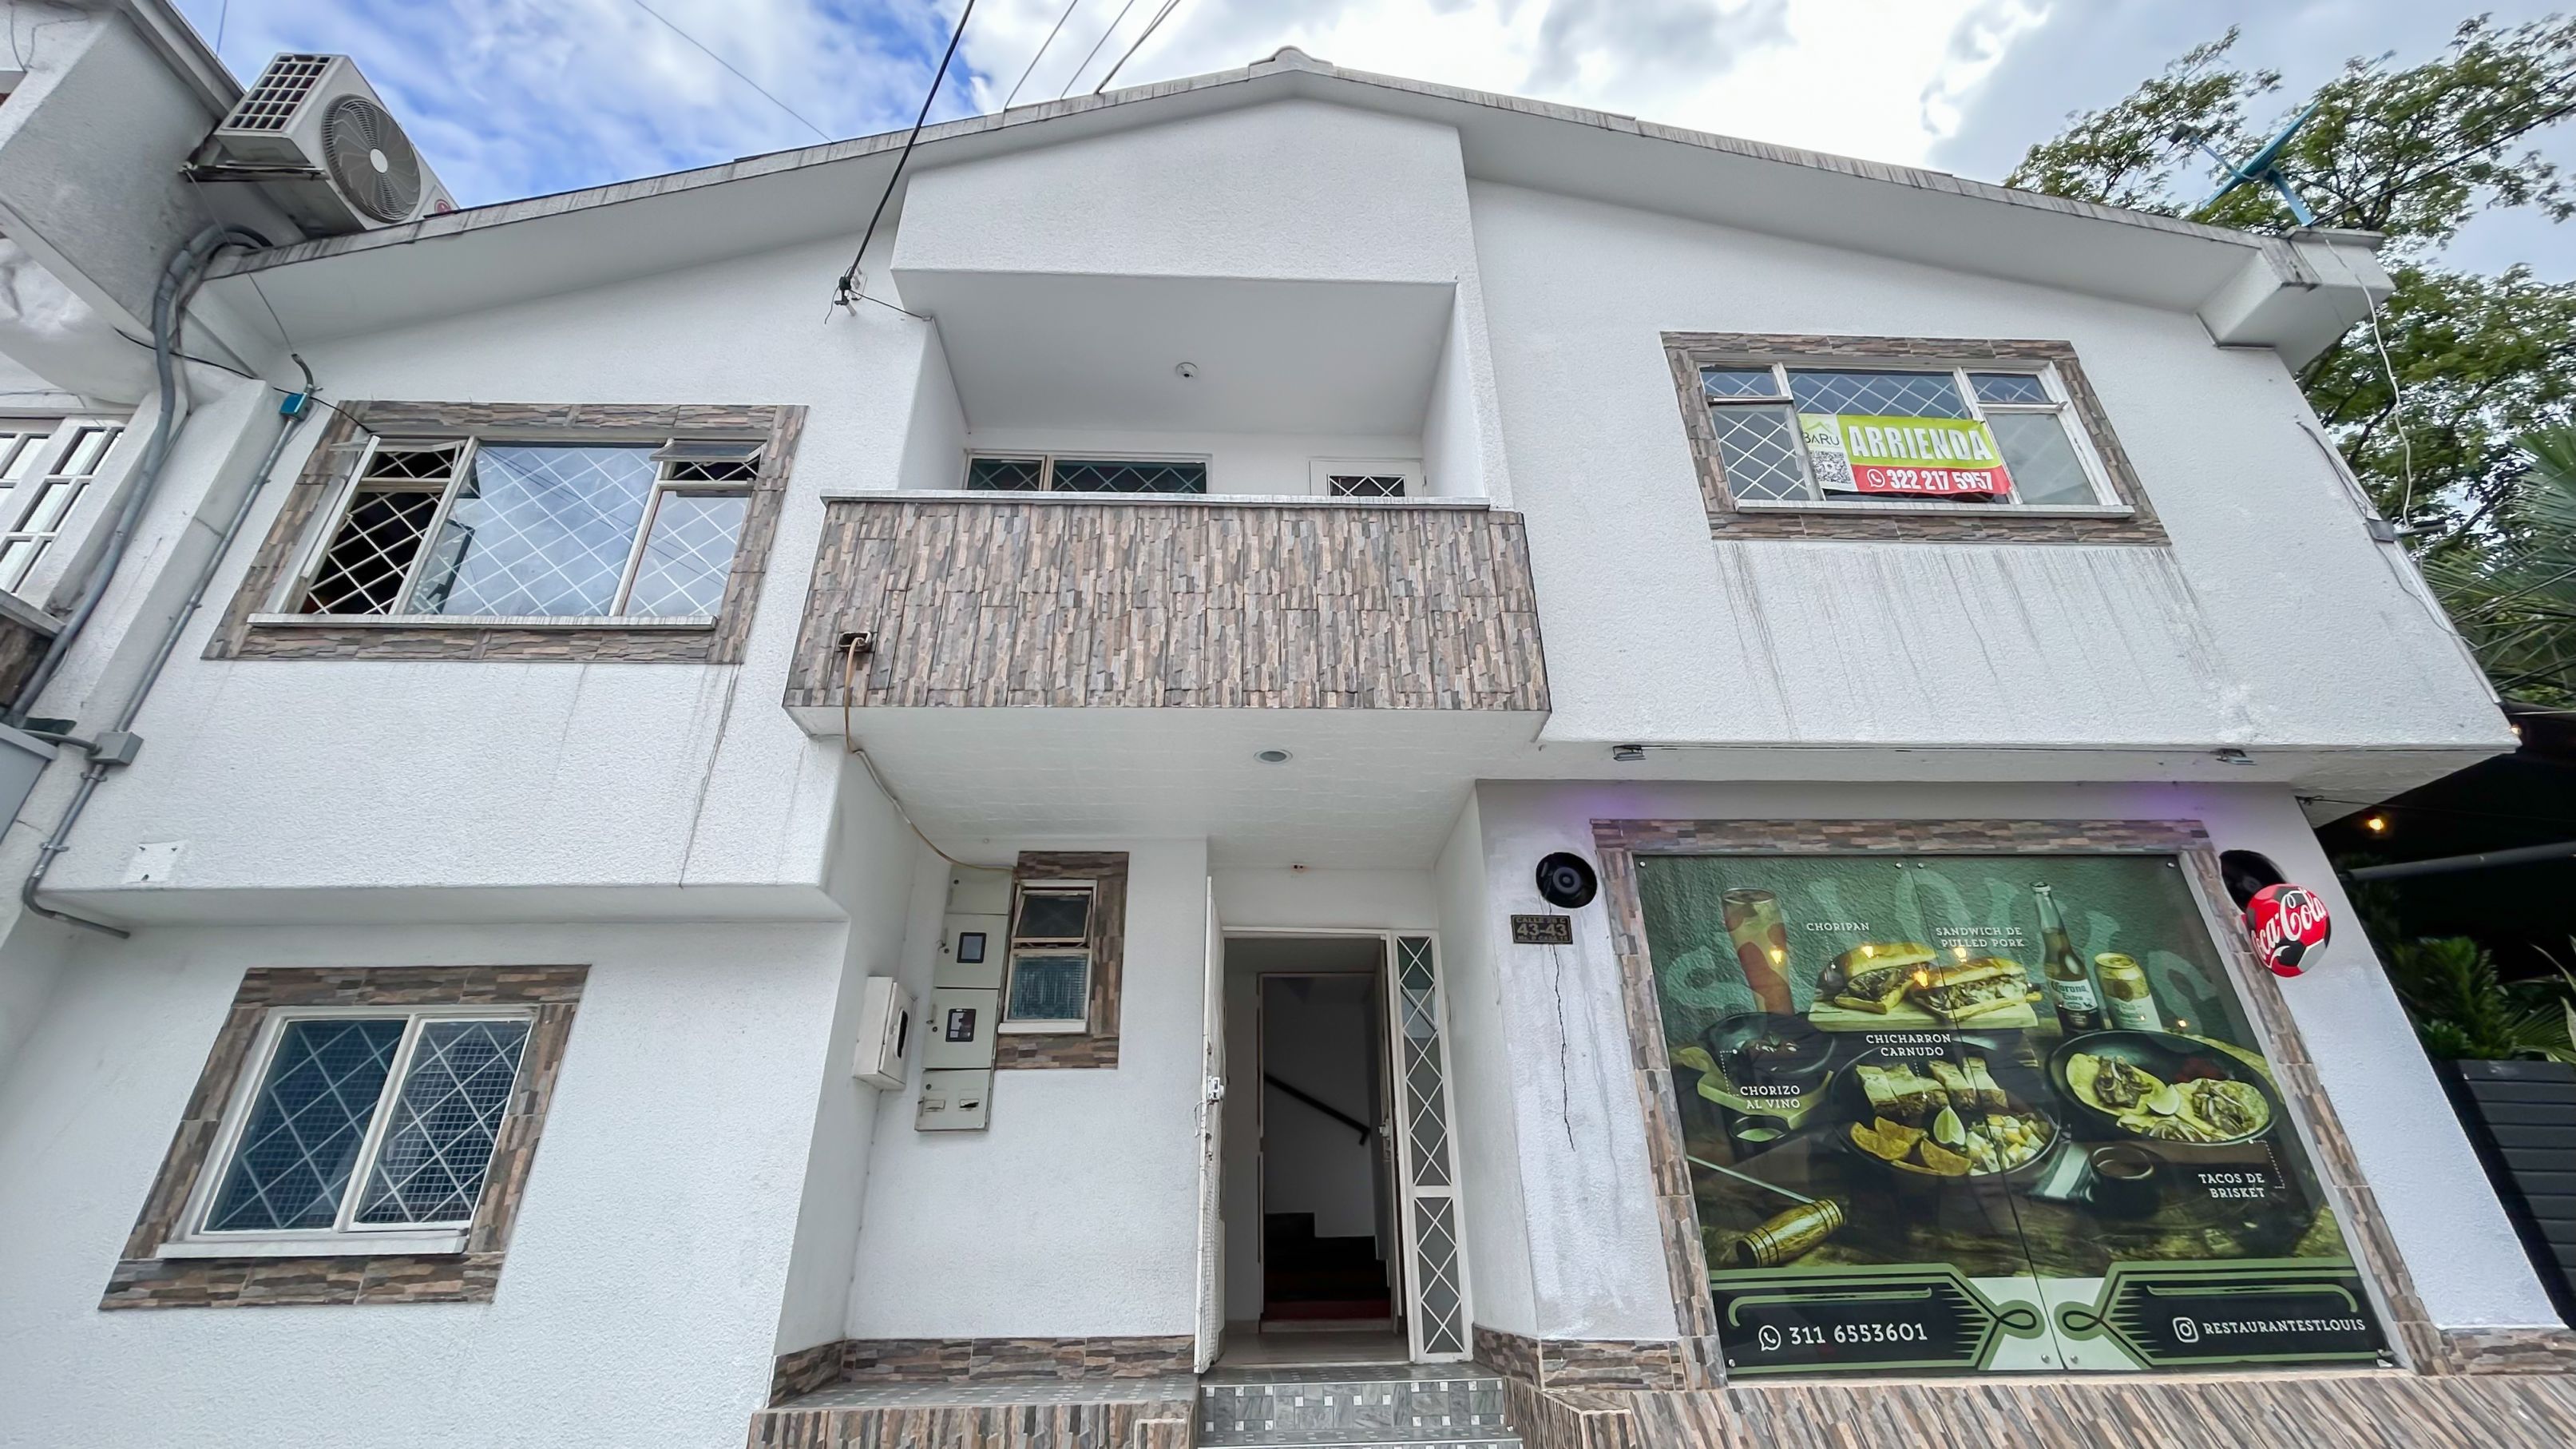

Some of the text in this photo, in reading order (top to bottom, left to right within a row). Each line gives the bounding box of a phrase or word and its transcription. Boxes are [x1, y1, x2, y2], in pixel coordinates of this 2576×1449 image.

[1848, 426, 1994, 461] ARRIENDA
[1887, 469, 1994, 490] 322 217 5957
[1517, 923, 1567, 936] 43-43
[1806, 922, 1870, 931] CHORIPAN
[1936, 927, 2022, 936] SANDWICH DE
[1941, 939, 2025, 947] PULLED PORK
[1865, 1034, 1952, 1044] CHICHARRON
[1880, 1047, 1944, 1057] CARNUDO
[1740, 1085, 1801, 1096] CHORIZO
[1746, 1098, 1801, 1110] AL VINO
[2198, 1173, 2265, 1184] TACOS DE
[2209, 1188, 2265, 1198] BRISKET
[2202, 1319, 2366, 1335] RESTAURANTESTLOUIS
[1789, 1323, 1928, 1344] 311 6553601
